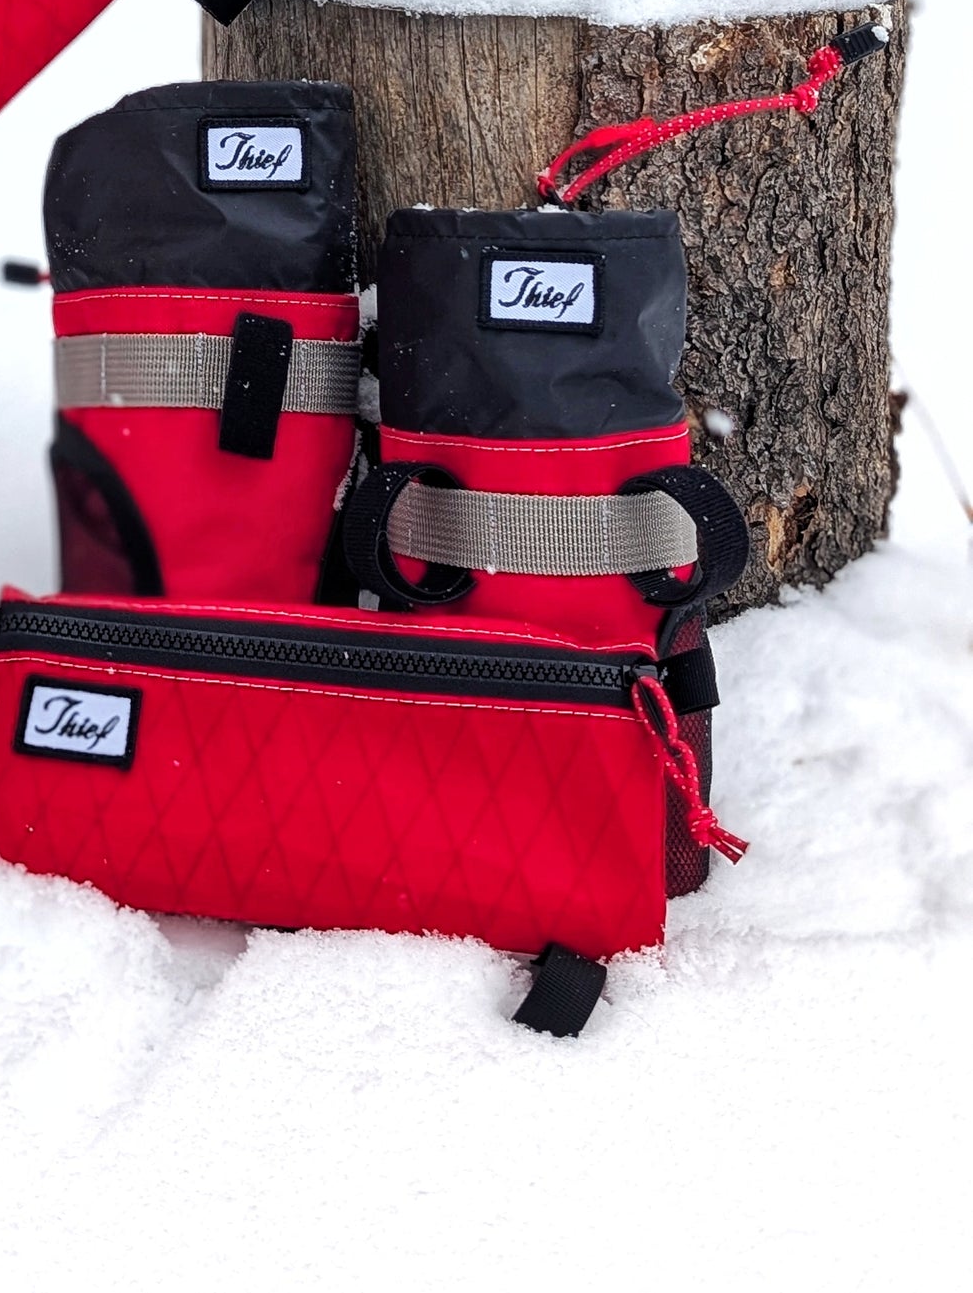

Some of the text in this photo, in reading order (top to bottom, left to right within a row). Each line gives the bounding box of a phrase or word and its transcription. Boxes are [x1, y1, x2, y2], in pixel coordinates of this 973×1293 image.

[215, 131, 292, 178] Thief
[498, 266, 585, 319] Thief
[34, 696, 120, 750] Thief
